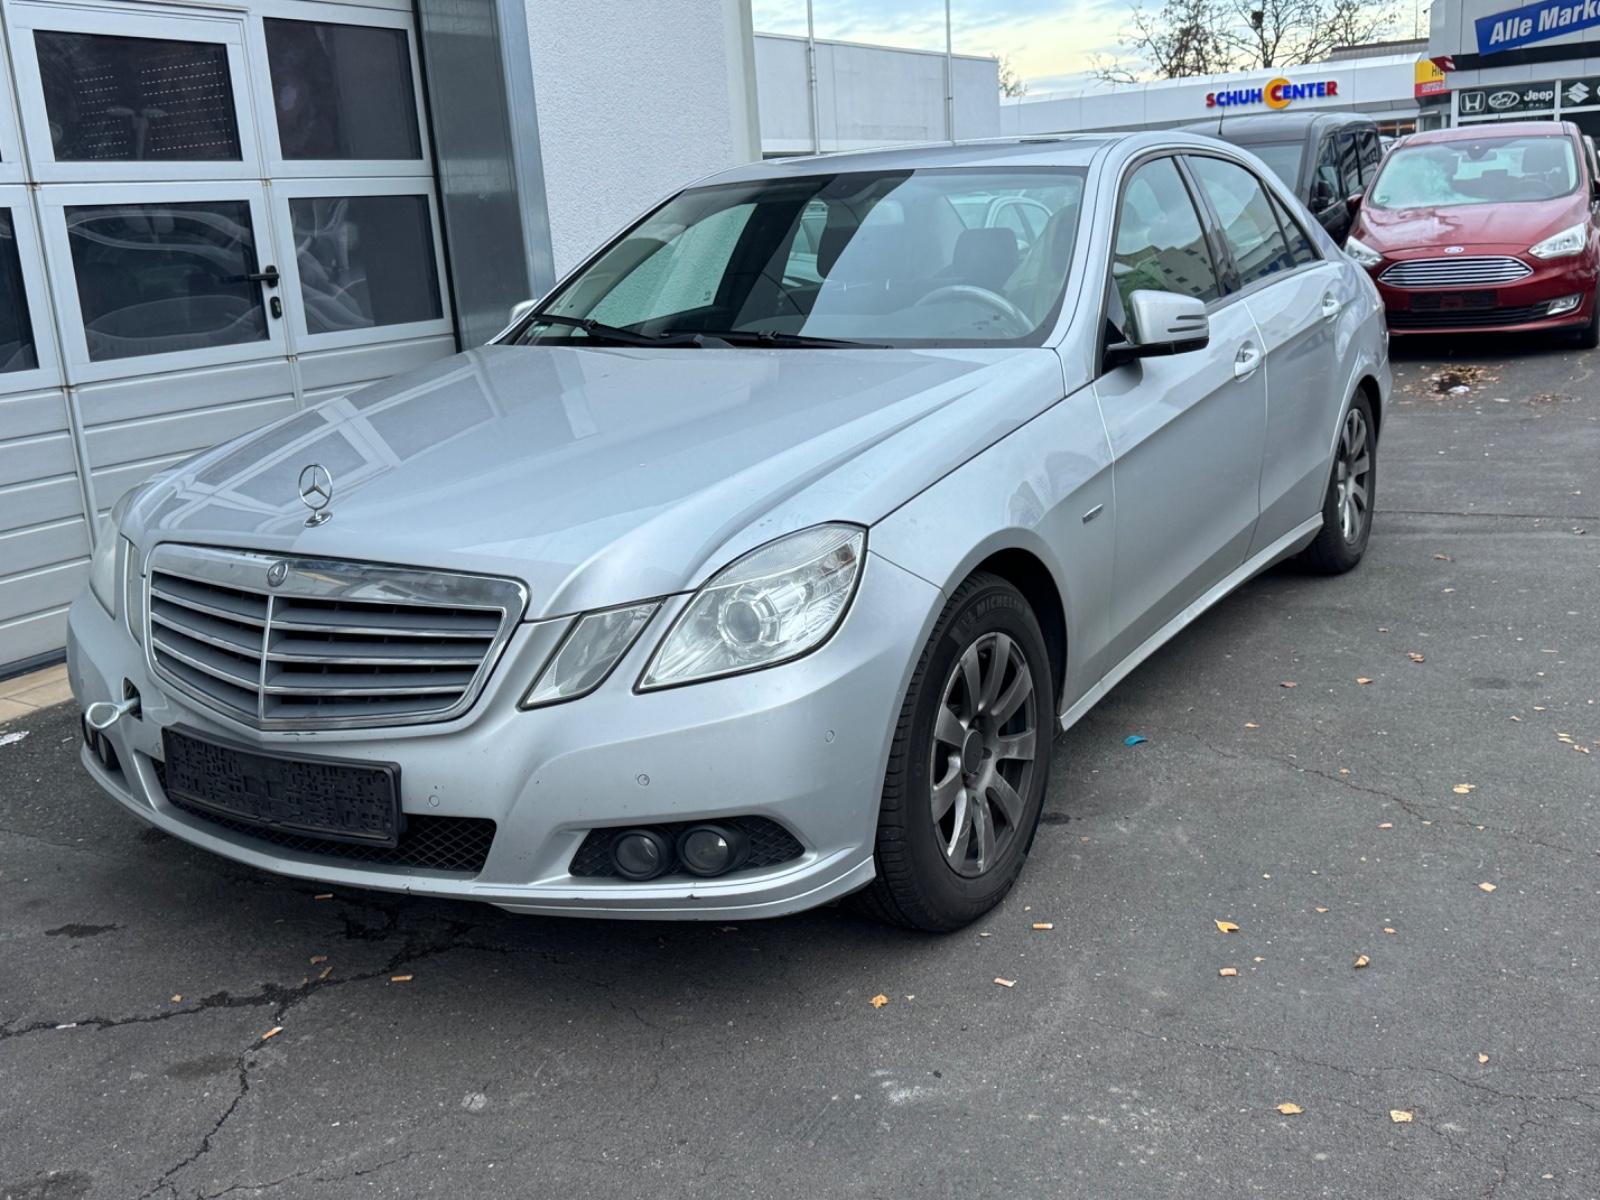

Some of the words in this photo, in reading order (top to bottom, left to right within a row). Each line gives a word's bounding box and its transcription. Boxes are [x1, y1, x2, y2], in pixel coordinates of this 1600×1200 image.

[1489, 18, 1533, 45] Alle
[1538, 0, 1600, 32] Mark
[1206, 87, 1263, 108] SCHUH
[1524, 90, 1553, 102] Jeep
[977, 594, 1024, 616] MICHELIN
